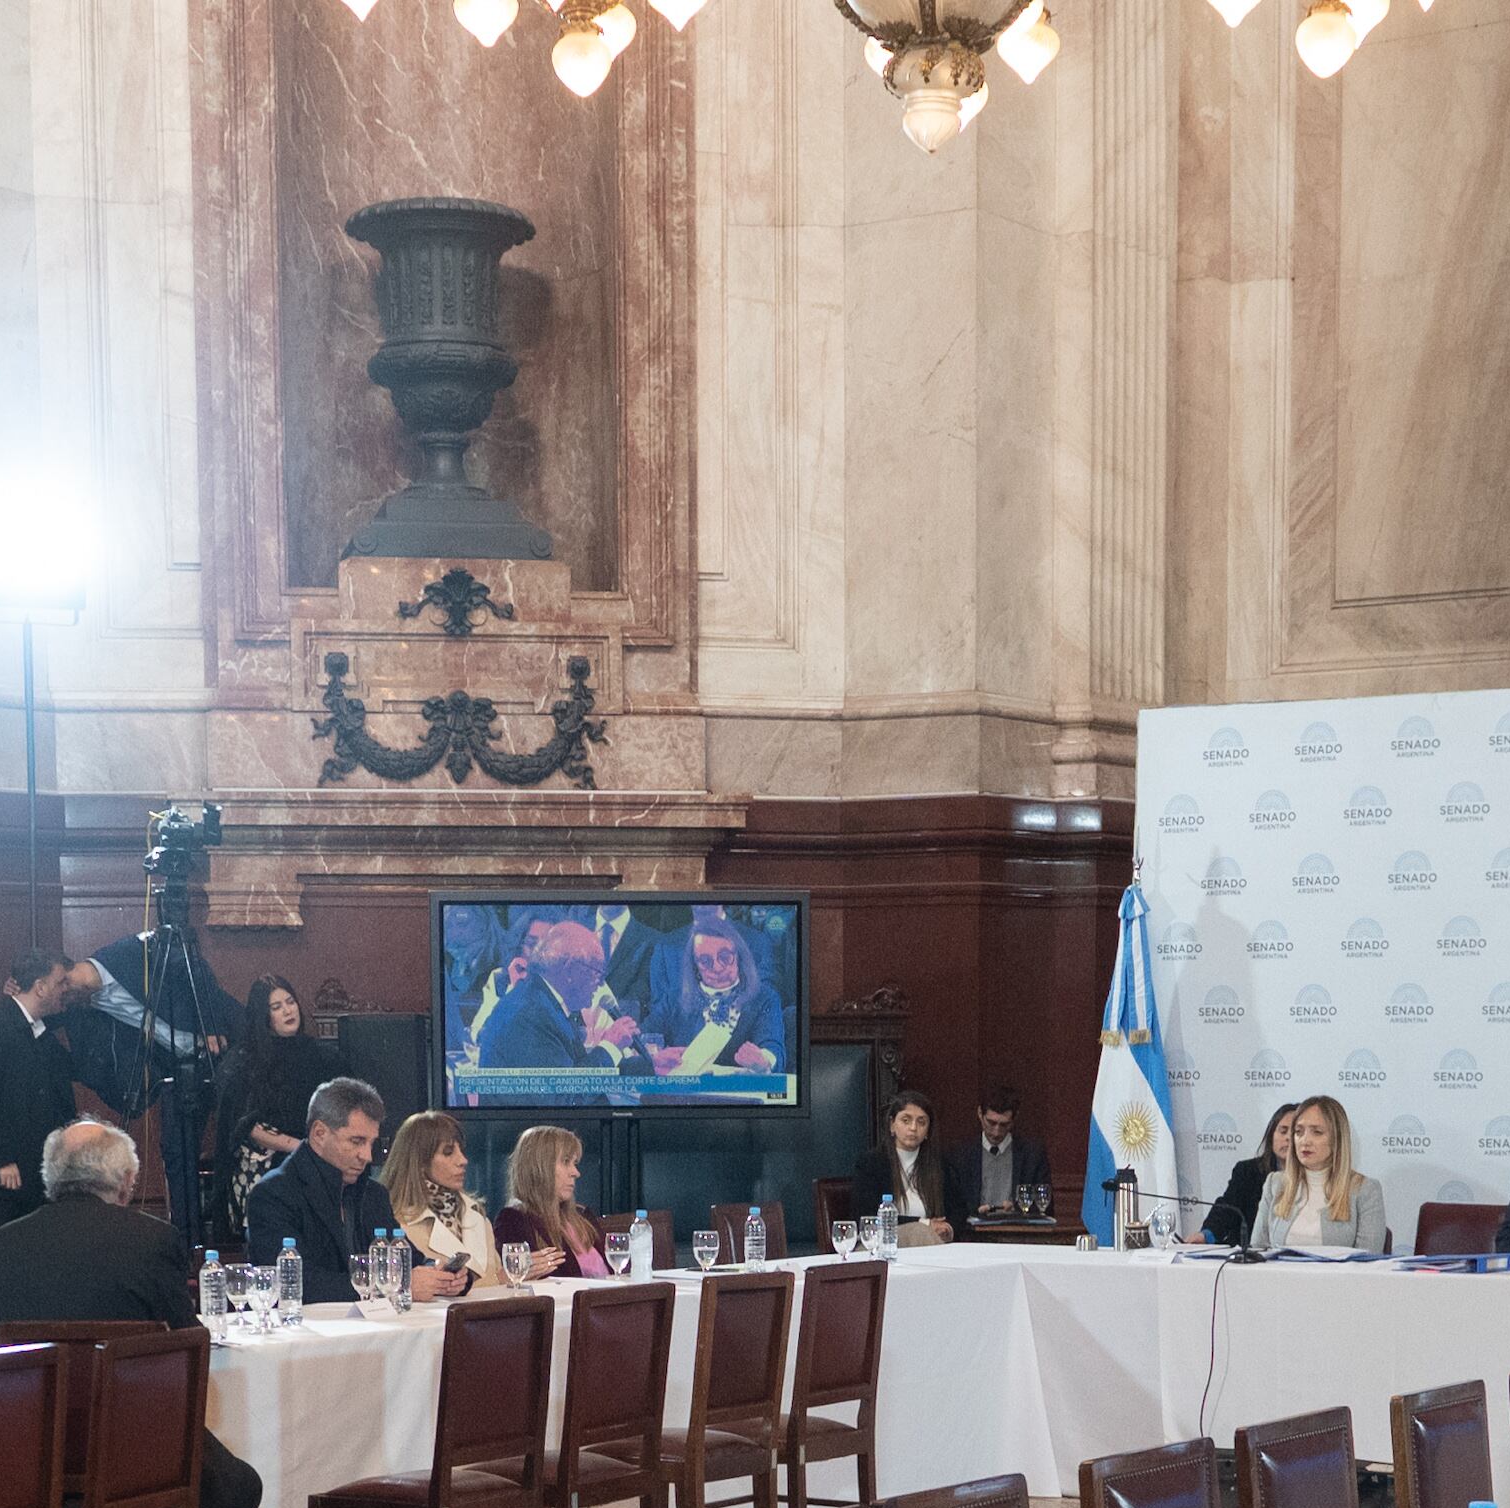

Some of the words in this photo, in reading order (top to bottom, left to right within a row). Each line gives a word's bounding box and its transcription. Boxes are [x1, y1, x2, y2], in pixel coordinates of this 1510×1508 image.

[1294, 744, 1343, 755] SENADO
[1391, 738, 1441, 751] SENADO
[1203, 749, 1249, 760] SENADO
[1343, 808, 1393, 819] SENADO
[1440, 804, 1490, 815] SENADO
[1159, 816, 1205, 826] SENADO
[1249, 812, 1296, 823] SENADO
[1292, 876, 1340, 886] SENADO
[1388, 873, 1437, 884] SENADO
[1200, 879, 1247, 889] SENADO
[1157, 944, 1203, 954] SENADO
[1246, 942, 1294, 952] SENADO
[1341, 940, 1389, 950] SENADO
[1436, 939, 1487, 949] SENADO
[1198, 1007, 1245, 1017] SENADO
[1289, 1006, 1337, 1016] SENADO
[1385, 1006, 1434, 1016] SENADO
[1168, 1071, 1201, 1080] NADO
[1244, 1071, 1291, 1080] SENADO
[1338, 1071, 1386, 1081] SENADO
[1433, 1072, 1483, 1082] SENADO
[549, 1077, 602, 1085] CANDIDATO
[625, 1077, 656, 1085] CORTE
[658, 1077, 700, 1085] SUPREMA
[476, 1086, 514, 1094] JUSTICIA
[591, 1086, 637, 1094] MANSILLA
[1196, 1134, 1243, 1144] SENADO
[1382, 1137, 1431, 1147] SENADO
